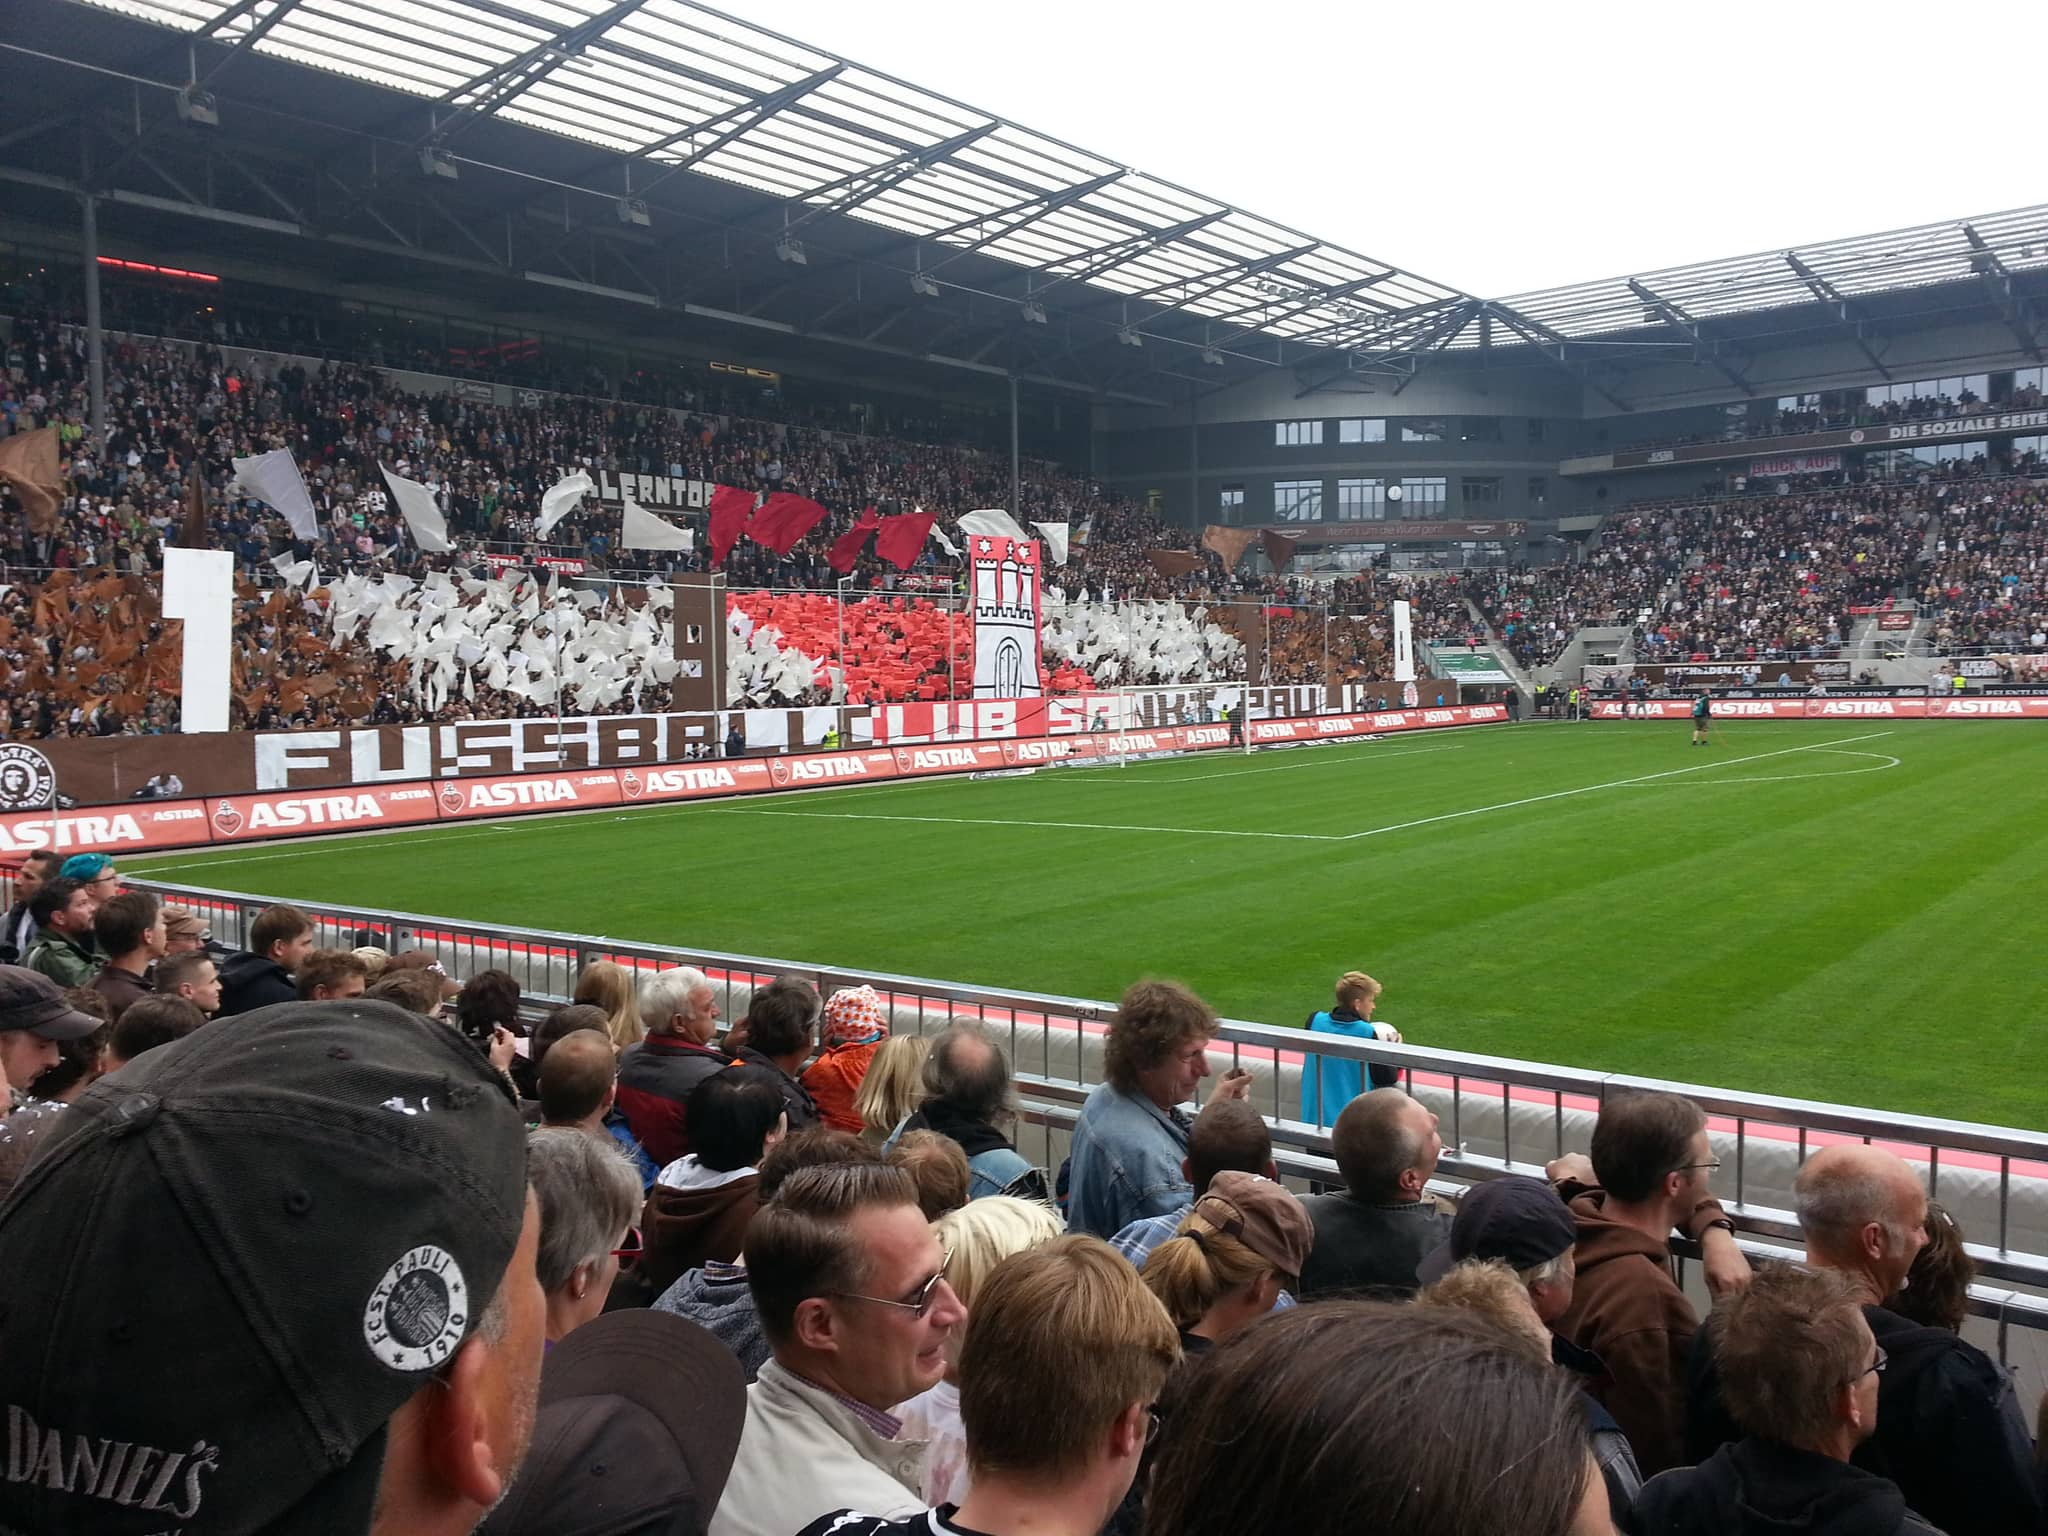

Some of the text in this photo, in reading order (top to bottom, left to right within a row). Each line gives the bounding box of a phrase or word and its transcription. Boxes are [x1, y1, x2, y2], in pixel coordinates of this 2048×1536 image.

[1889, 412, 2048, 439] DIE SOZIALE SEITE
[1470, 706, 1498, 719] ASTRA
[1709, 703, 1775, 715] ASTRA
[1823, 701, 1895, 714] ASTRA
[1946, 701, 2023, 713] ASTRA
[837, 701, 1017, 746] CLUB
[1373, 712, 1406, 728] ASTRA
[1424, 710, 1454, 723] ASTRA
[1257, 723, 1296, 738] ASTRA
[1318, 718, 1354, 733] ASTRA
[1109, 734, 1157, 752] ASTRA
[1186, 728, 1230, 745] ASTRA
[1018, 740, 1072, 760] ASTRA
[914, 749, 977, 769] ASTRA
[792, 756, 867, 780] ASTRA
[582, 776, 616, 785] ASTRA
[646, 767, 736, 793] ASTRA
[390, 789, 432, 800] ASTRA
[469, 779, 577, 808] ASTRA
[153, 809, 204, 821] ASTRA
[248, 794, 384, 829] ASTRA
[394, 1248, 450, 1280] PAULI
[423, 1313, 466, 1364] 1910
[7, 1404, 220, 1519] DANIEL'S
